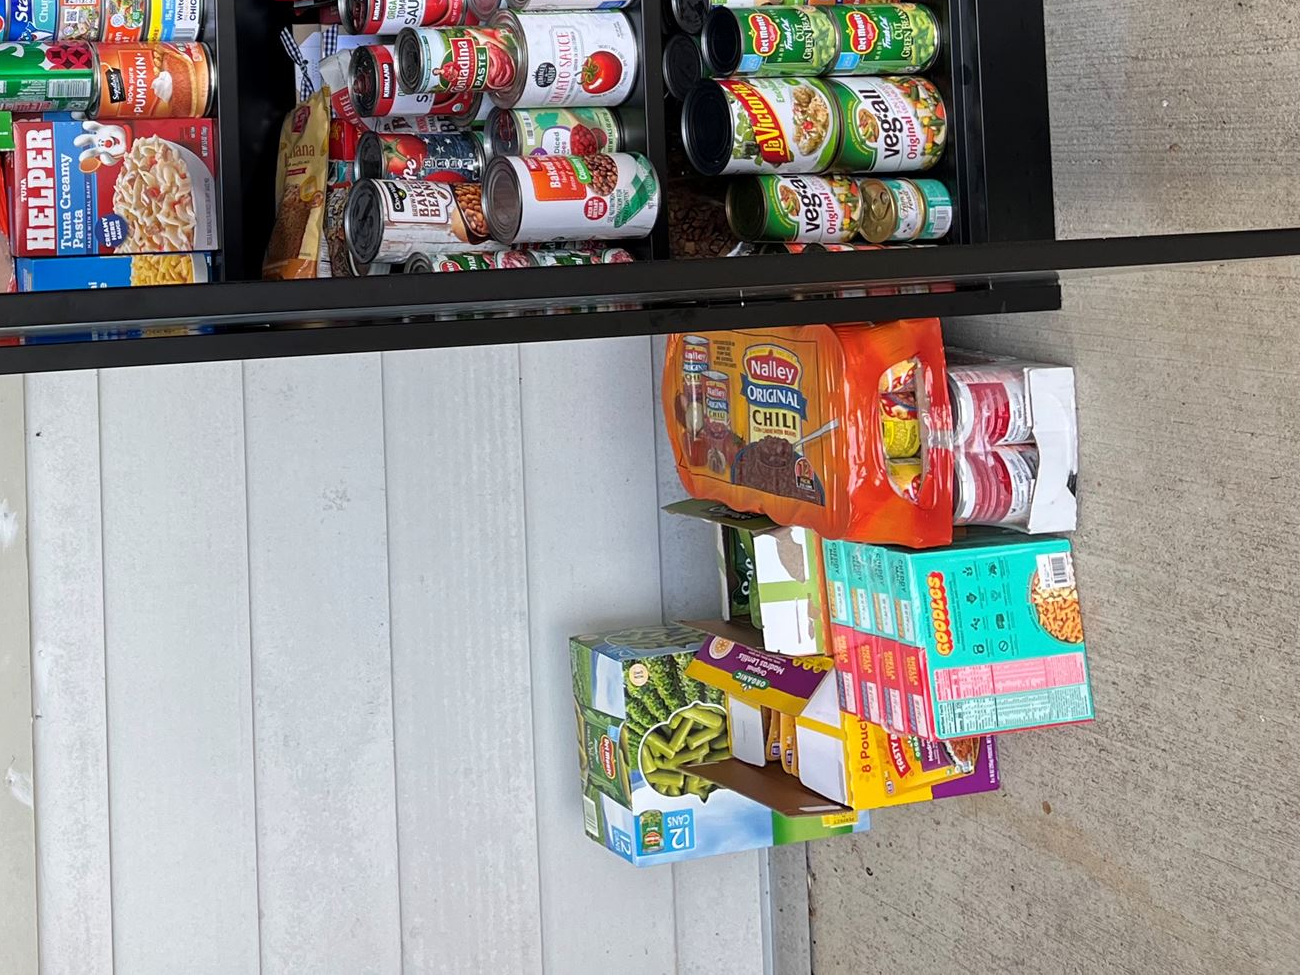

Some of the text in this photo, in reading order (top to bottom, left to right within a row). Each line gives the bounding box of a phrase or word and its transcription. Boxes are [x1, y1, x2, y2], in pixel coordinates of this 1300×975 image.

[755, 15, 769, 53] Del Monte
[795, 23, 804, 42] CUT
[852, 13, 867, 51] Del Monte
[893, 22, 902, 40] CUT
[900, 31, 912, 57] GREEN
[556, 32, 572, 67] SAUCE
[802, 32, 813, 59] GREEN
[475, 53, 486, 86] PASTE
[135, 57, 147, 113] PUMPKIN
[340, 94, 354, 116] FREE
[731, 83, 787, 155] La Victoria
[901, 115, 920, 160] Original
[545, 162, 562, 188] Baked
[26, 129, 55, 250] HELPER
[60, 153, 72, 249] Tuna Creamy
[409, 193, 419, 216] BROWN
[819, 192, 839, 235] Original
[72, 209, 84, 248] Pasta
[101, 217, 111, 247] CREAMY
[751, 360, 795, 383] Nalley
[747, 385, 800, 409] ORIGINAL
[752, 409, 796, 430] CHILI
[927, 576, 950, 654] GOODLES
[735, 671, 767, 687] ORGANIC
[746, 664, 767, 676] Original
[861, 764, 872, 773] 8
[891, 742, 906, 772] TASTY
[667, 816, 691, 825] CANS
[670, 826, 691, 849] 12
